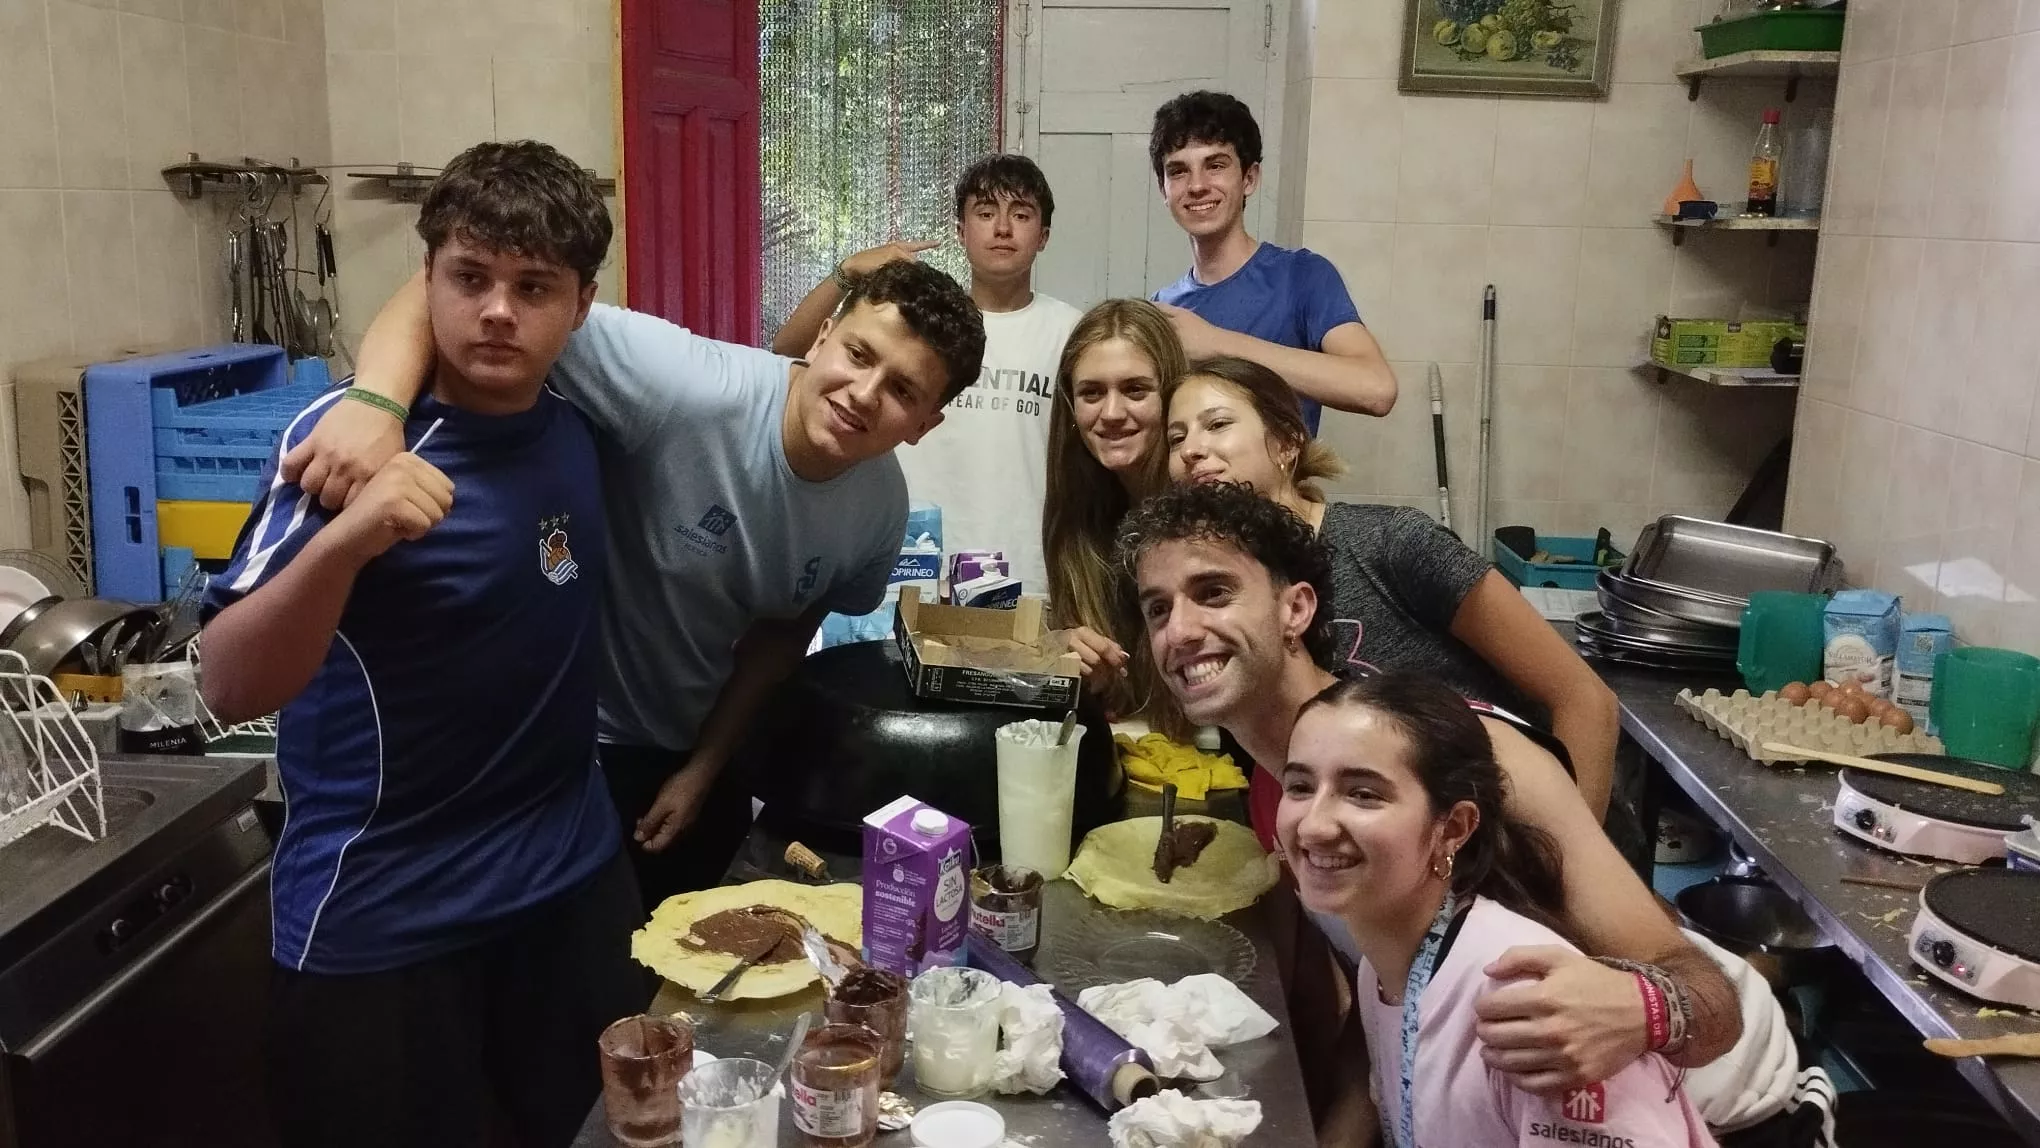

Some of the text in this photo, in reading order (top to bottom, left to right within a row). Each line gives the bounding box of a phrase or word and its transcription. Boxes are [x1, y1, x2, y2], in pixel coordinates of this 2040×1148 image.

[973, 367, 1052, 399] NTIAL
[991, 396, 1010, 411] OF
[1016, 399, 1040, 416] GOD
[891, 567, 934, 577] OPIRINEO
[149, 737, 188, 748] MILENIA
[943, 874, 957, 892] SIN
[875, 889, 917, 908] sostenible
[936, 884, 963, 908] LACTOSA
[1640, 974, 1661, 1021] ONISTAS
[792, 1087, 817, 1108] ella
[1529, 1122, 1635, 1148] salesianos
